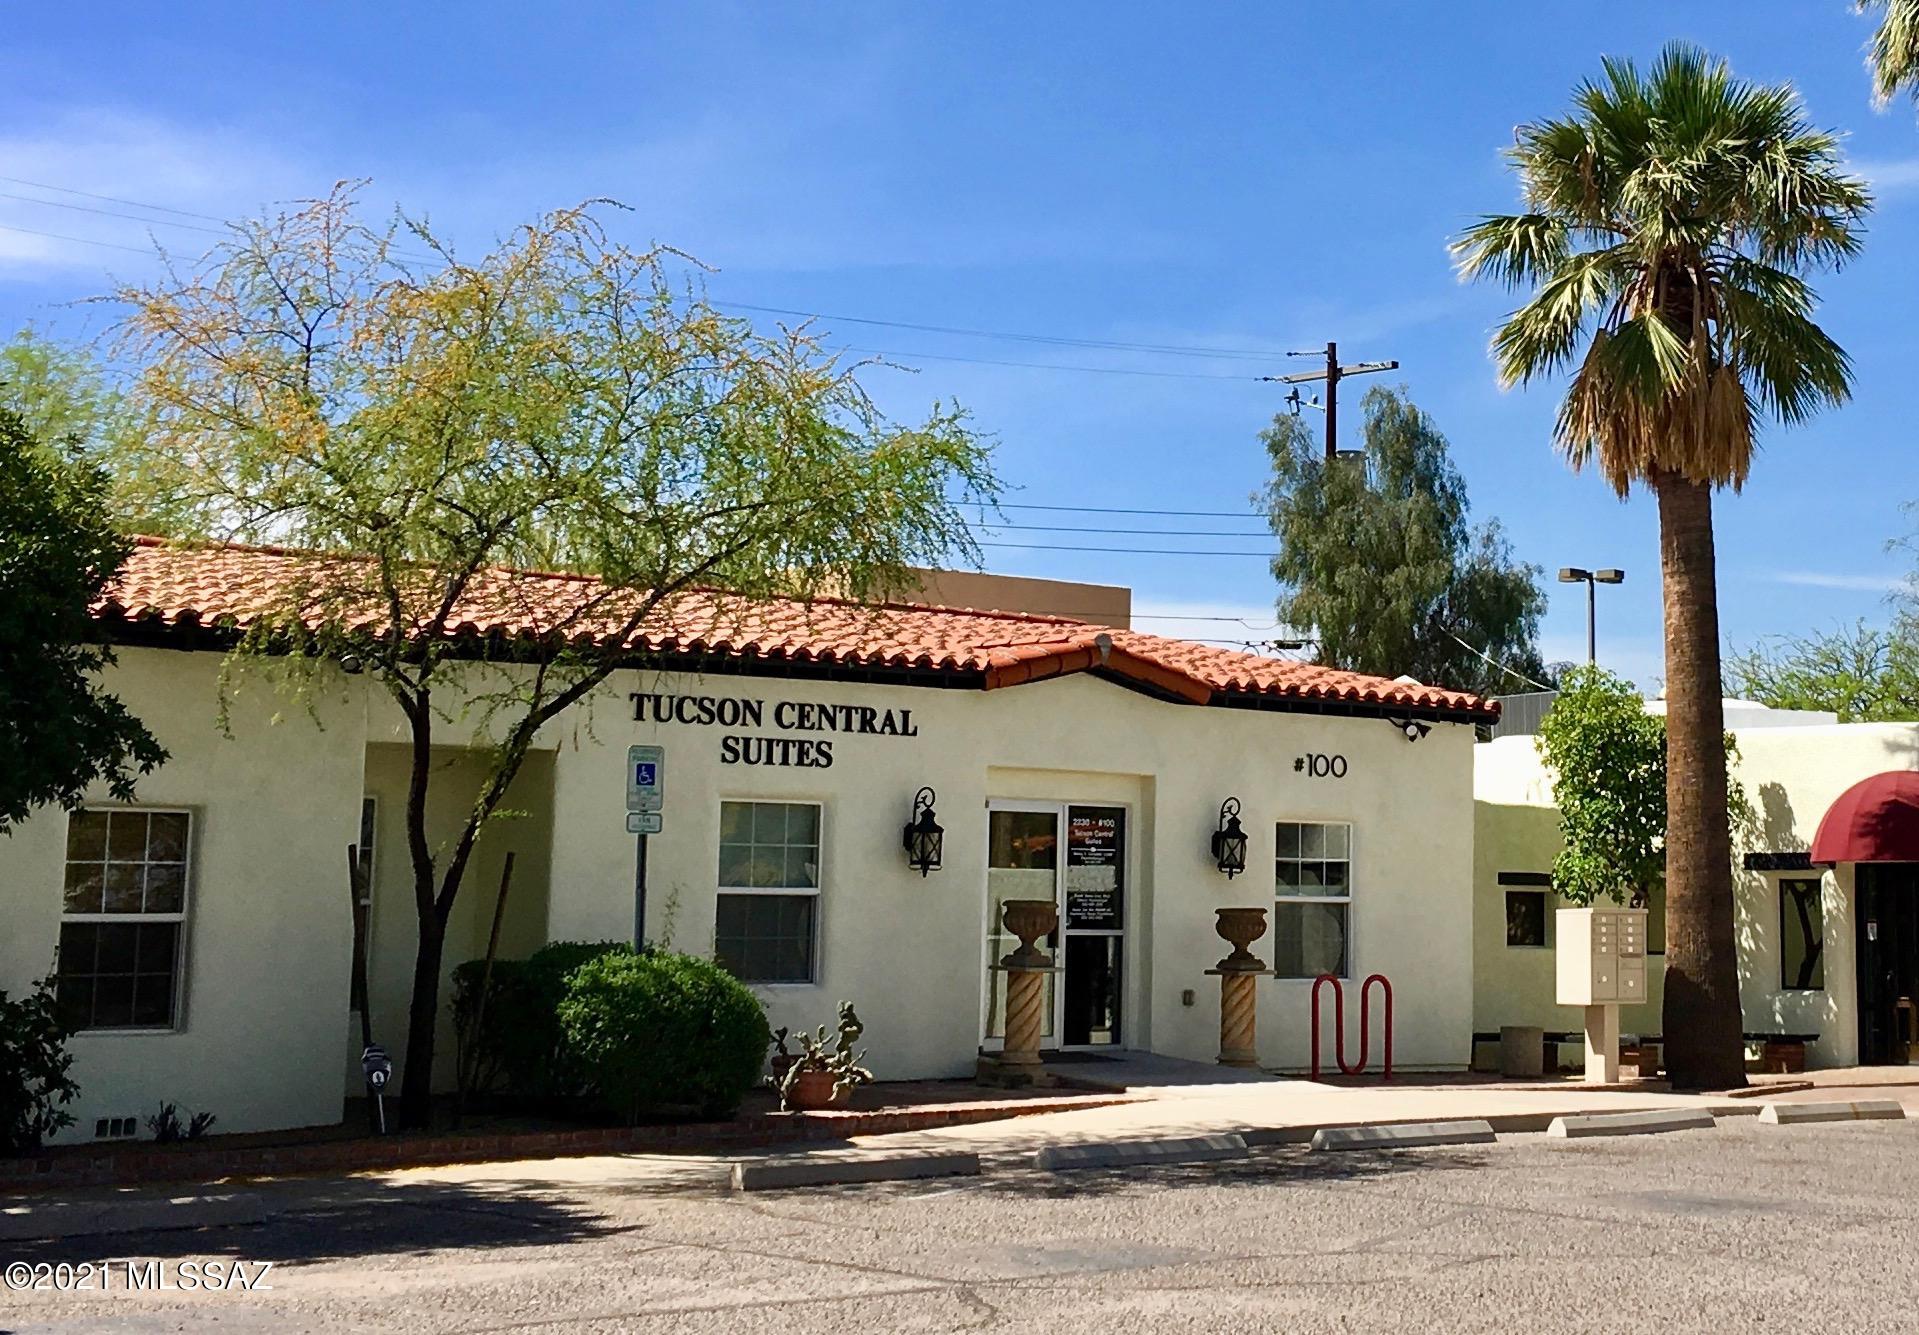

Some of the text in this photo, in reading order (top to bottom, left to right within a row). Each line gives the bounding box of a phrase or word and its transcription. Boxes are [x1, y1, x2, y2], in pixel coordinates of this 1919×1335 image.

[629, 693, 918, 737] TUCSON CENTRAL
[720, 736, 834, 769] SUITES
[1294, 753, 1348, 778] #100
